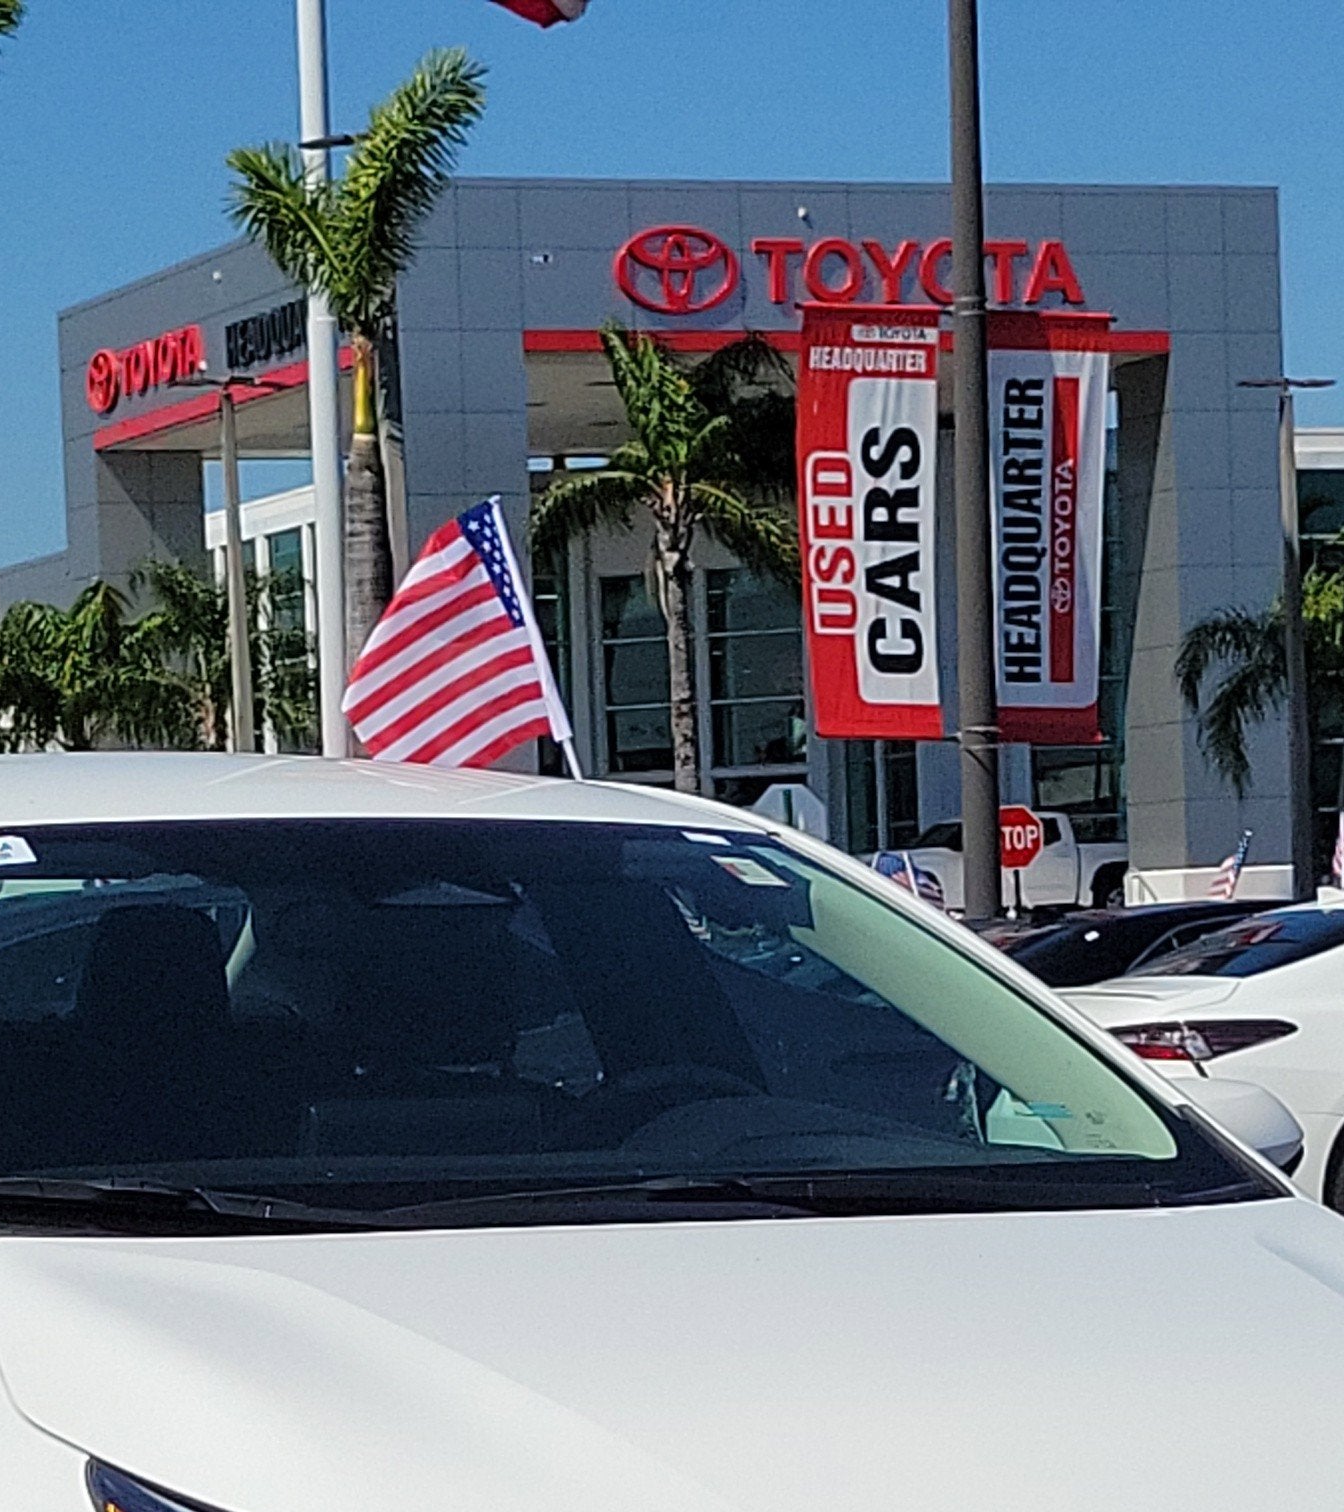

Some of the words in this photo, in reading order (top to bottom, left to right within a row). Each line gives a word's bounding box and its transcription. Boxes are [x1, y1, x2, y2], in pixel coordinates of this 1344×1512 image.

[751, 238, 1085, 305] TOYOTA
[116, 324, 202, 397] TOYOTA
[808, 345, 927, 373] HEADQUARTER
[878, 325, 928, 340] TOYOTA
[808, 452, 858, 633] USED
[861, 427, 924, 674] CARS
[1001, 376, 1047, 683] HEADQUARTER
[1054, 458, 1074, 574] TOYOTA
[1001, 825, 1039, 850] TOP
